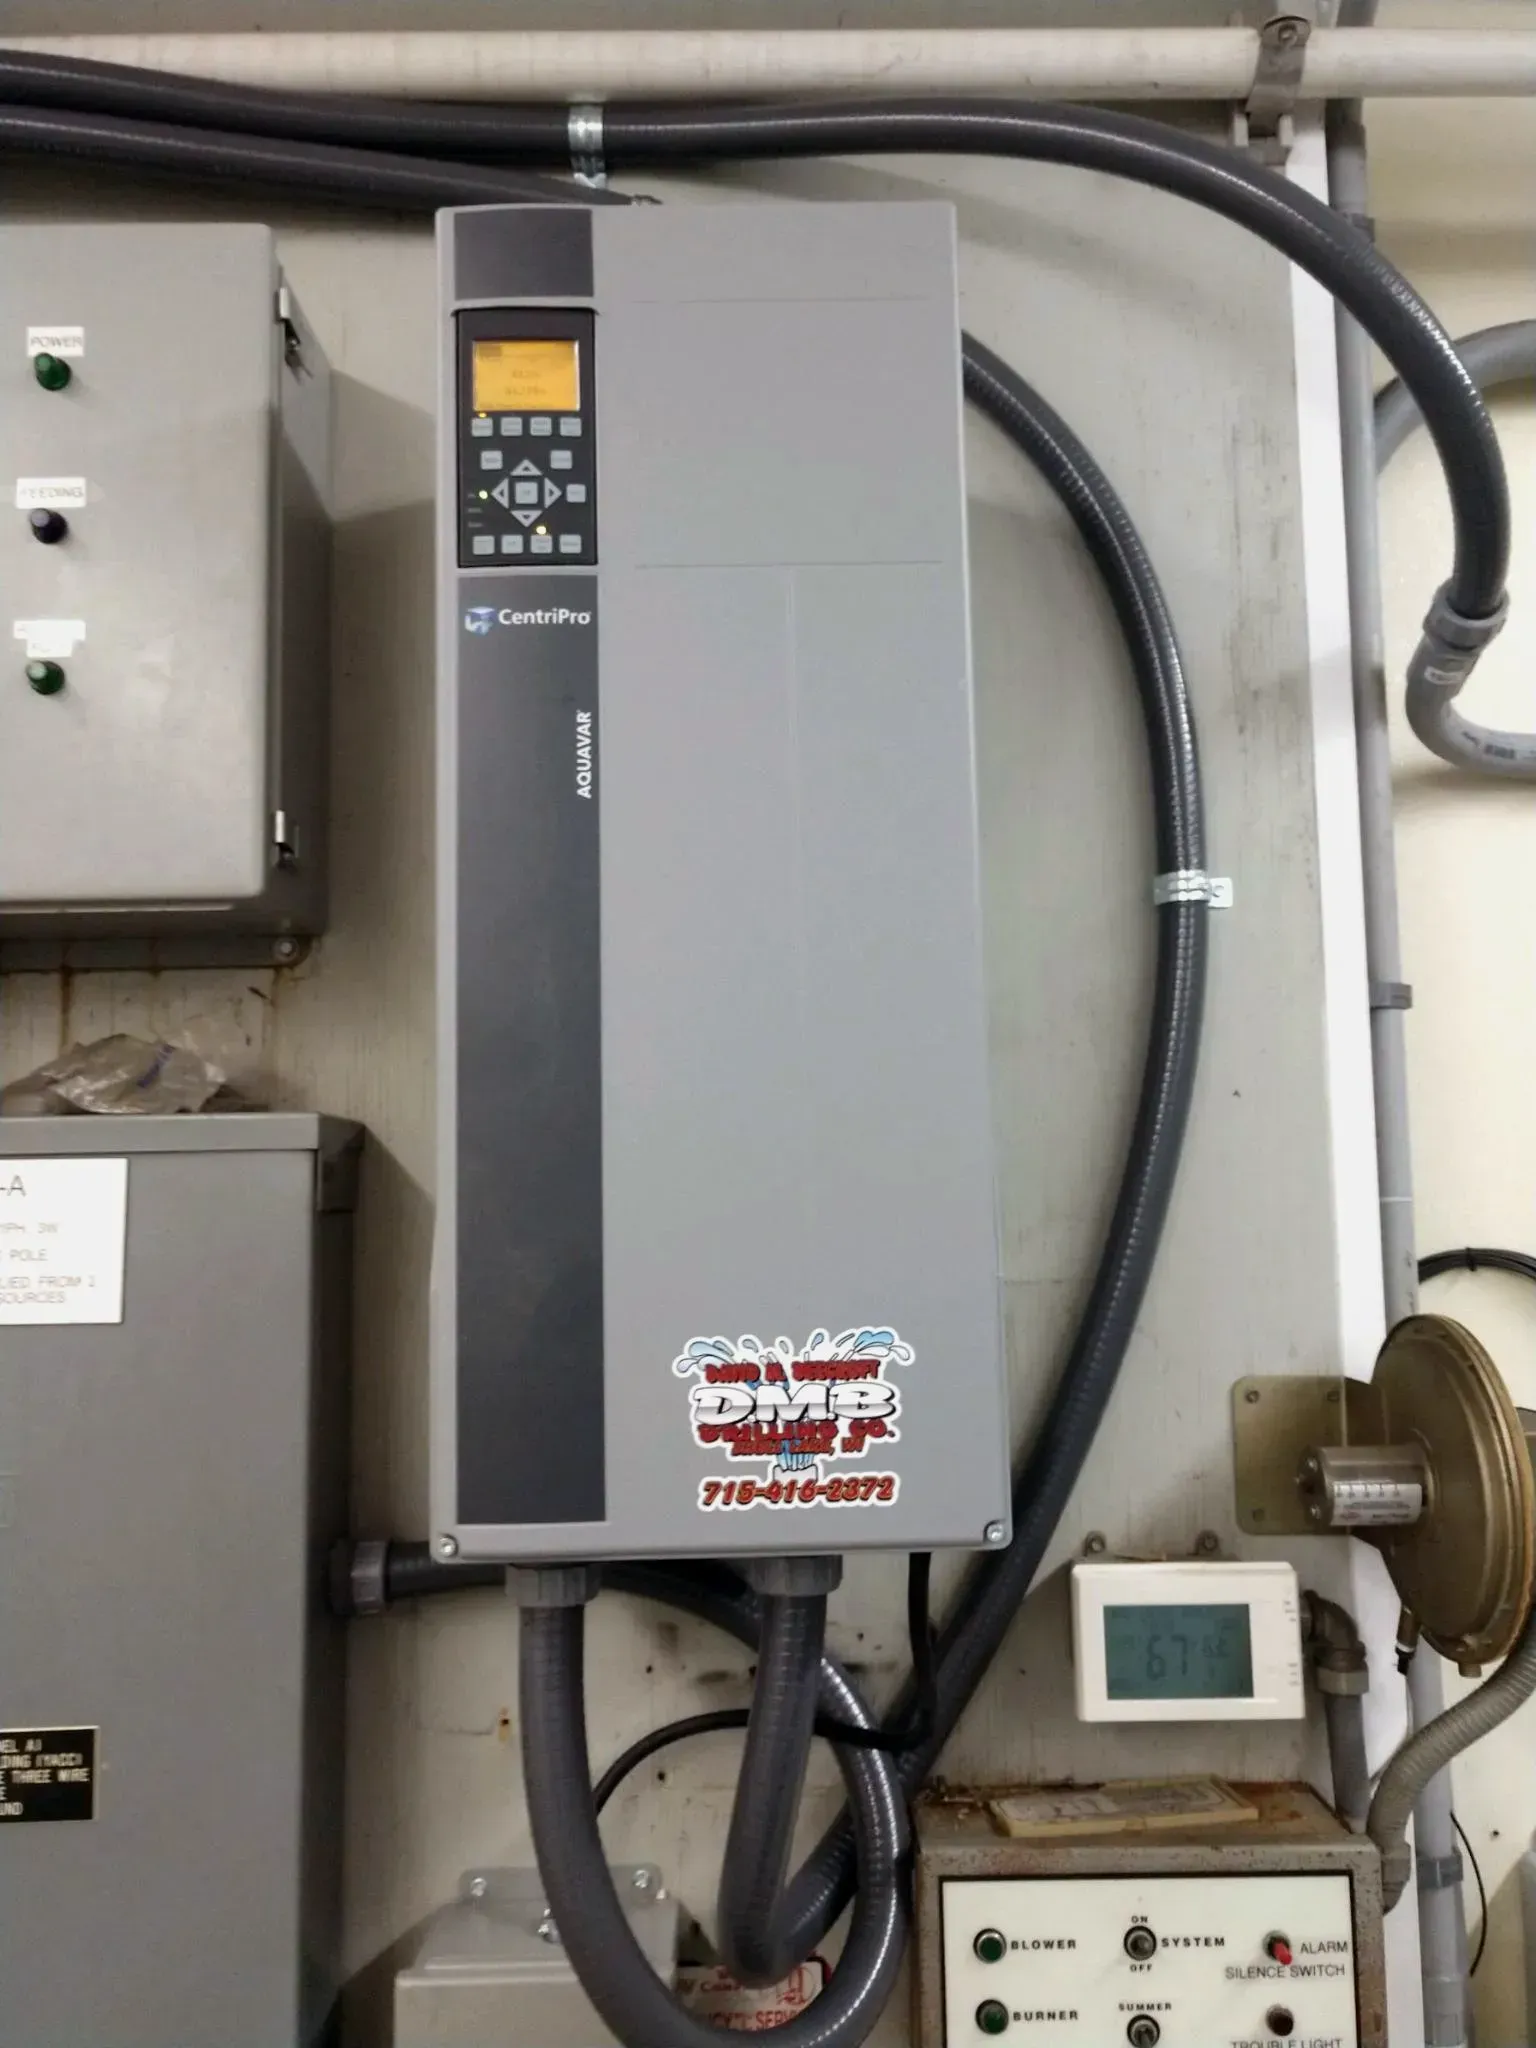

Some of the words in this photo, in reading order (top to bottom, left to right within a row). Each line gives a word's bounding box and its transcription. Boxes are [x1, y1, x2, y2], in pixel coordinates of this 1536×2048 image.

[30, 336, 83, 348] POWER
[498, 607, 591, 625] CentriPro
[576, 711, 592, 799] AQUAVAR
[703, 1476, 896, 1506] 715-416-2372
[1131, 1915, 1148, 1924] ON
[1010, 1939, 1077, 1951] BLOWER
[1161, 1936, 1225, 1948] SYSTEM
[1300, 1941, 1349, 1955] ALARM
[1130, 1963, 1153, 1973] OFF
[1225, 1965, 1286, 1980] SILENCE
[1289, 1964, 1346, 1979] SWITCH
[1118, 2002, 1173, 2012] SUMMER
[1013, 2010, 1080, 2022] BURNER
